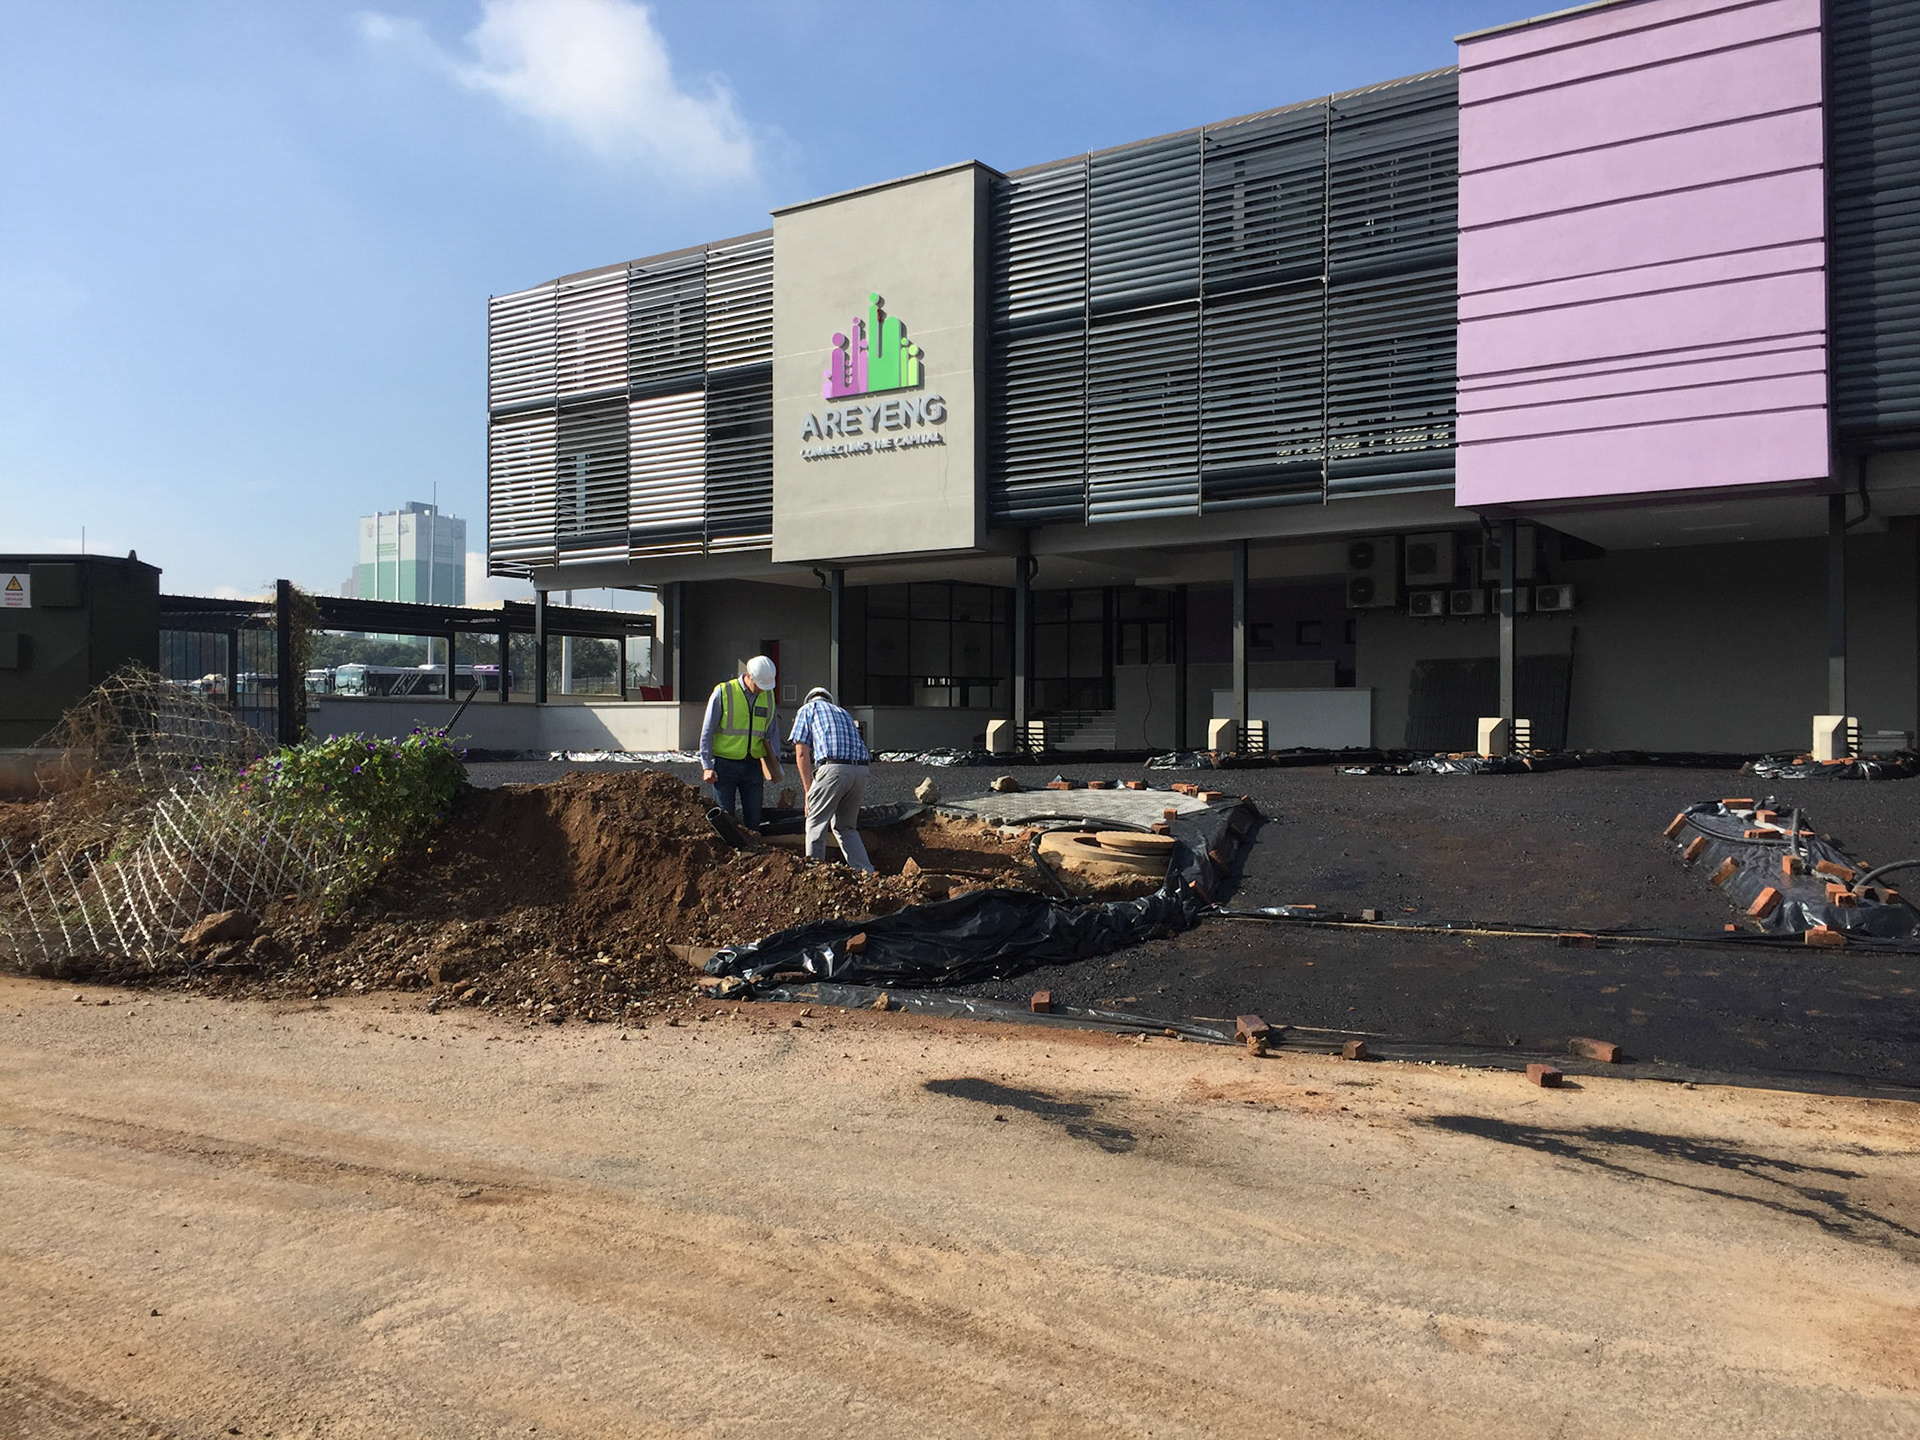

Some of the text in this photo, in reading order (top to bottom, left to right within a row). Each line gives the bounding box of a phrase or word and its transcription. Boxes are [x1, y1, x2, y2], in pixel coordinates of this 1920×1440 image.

[801, 393, 945, 437] AREYENG
[800, 432, 942, 459] CONNECTING THE CAPITAL
